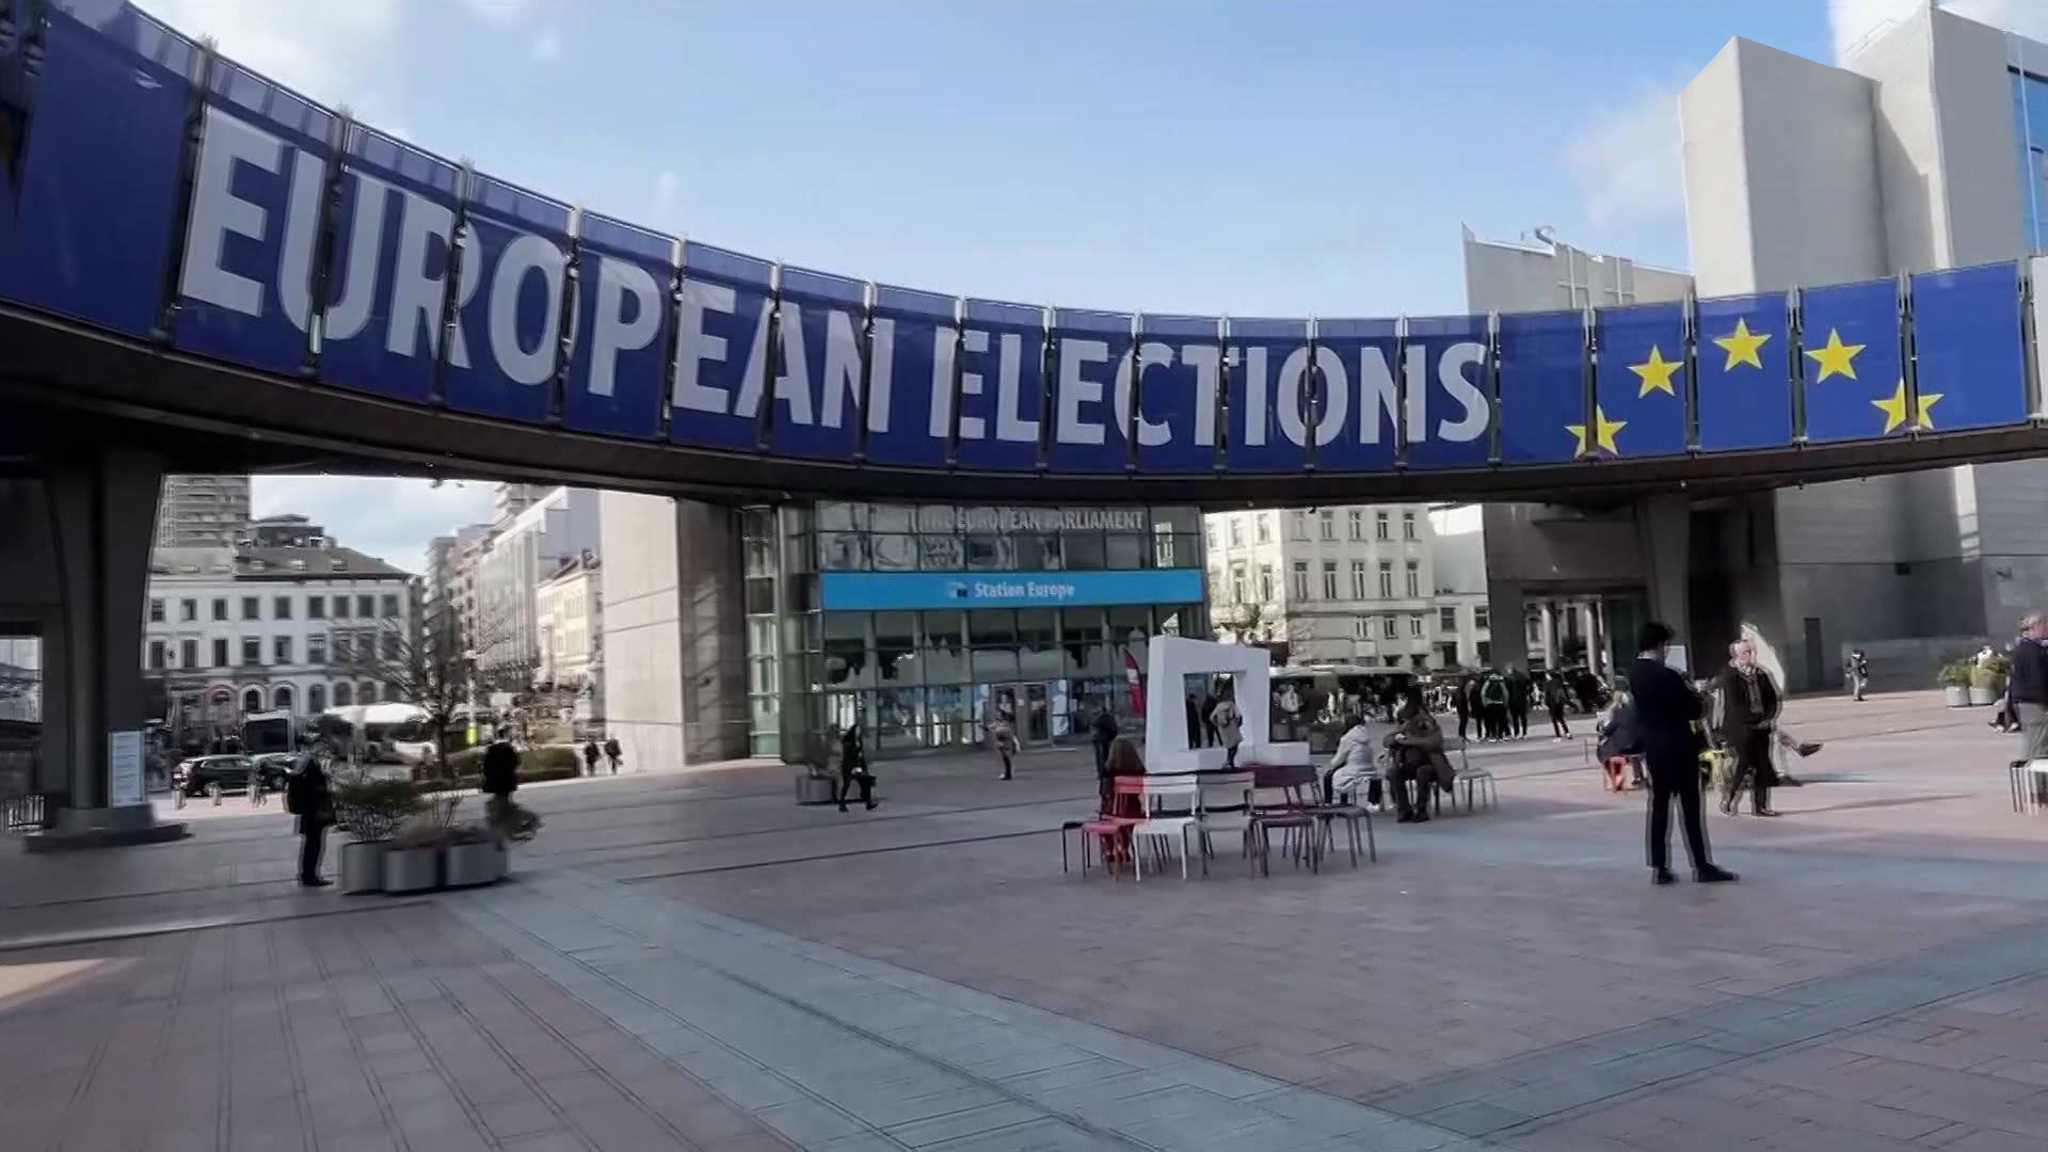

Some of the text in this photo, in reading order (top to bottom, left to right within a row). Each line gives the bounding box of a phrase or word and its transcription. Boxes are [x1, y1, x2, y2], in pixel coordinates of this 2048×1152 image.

[177, 104, 1490, 447] EUROPEAN ELECTIONS
[974, 581, 1076, 600] Station Europe
